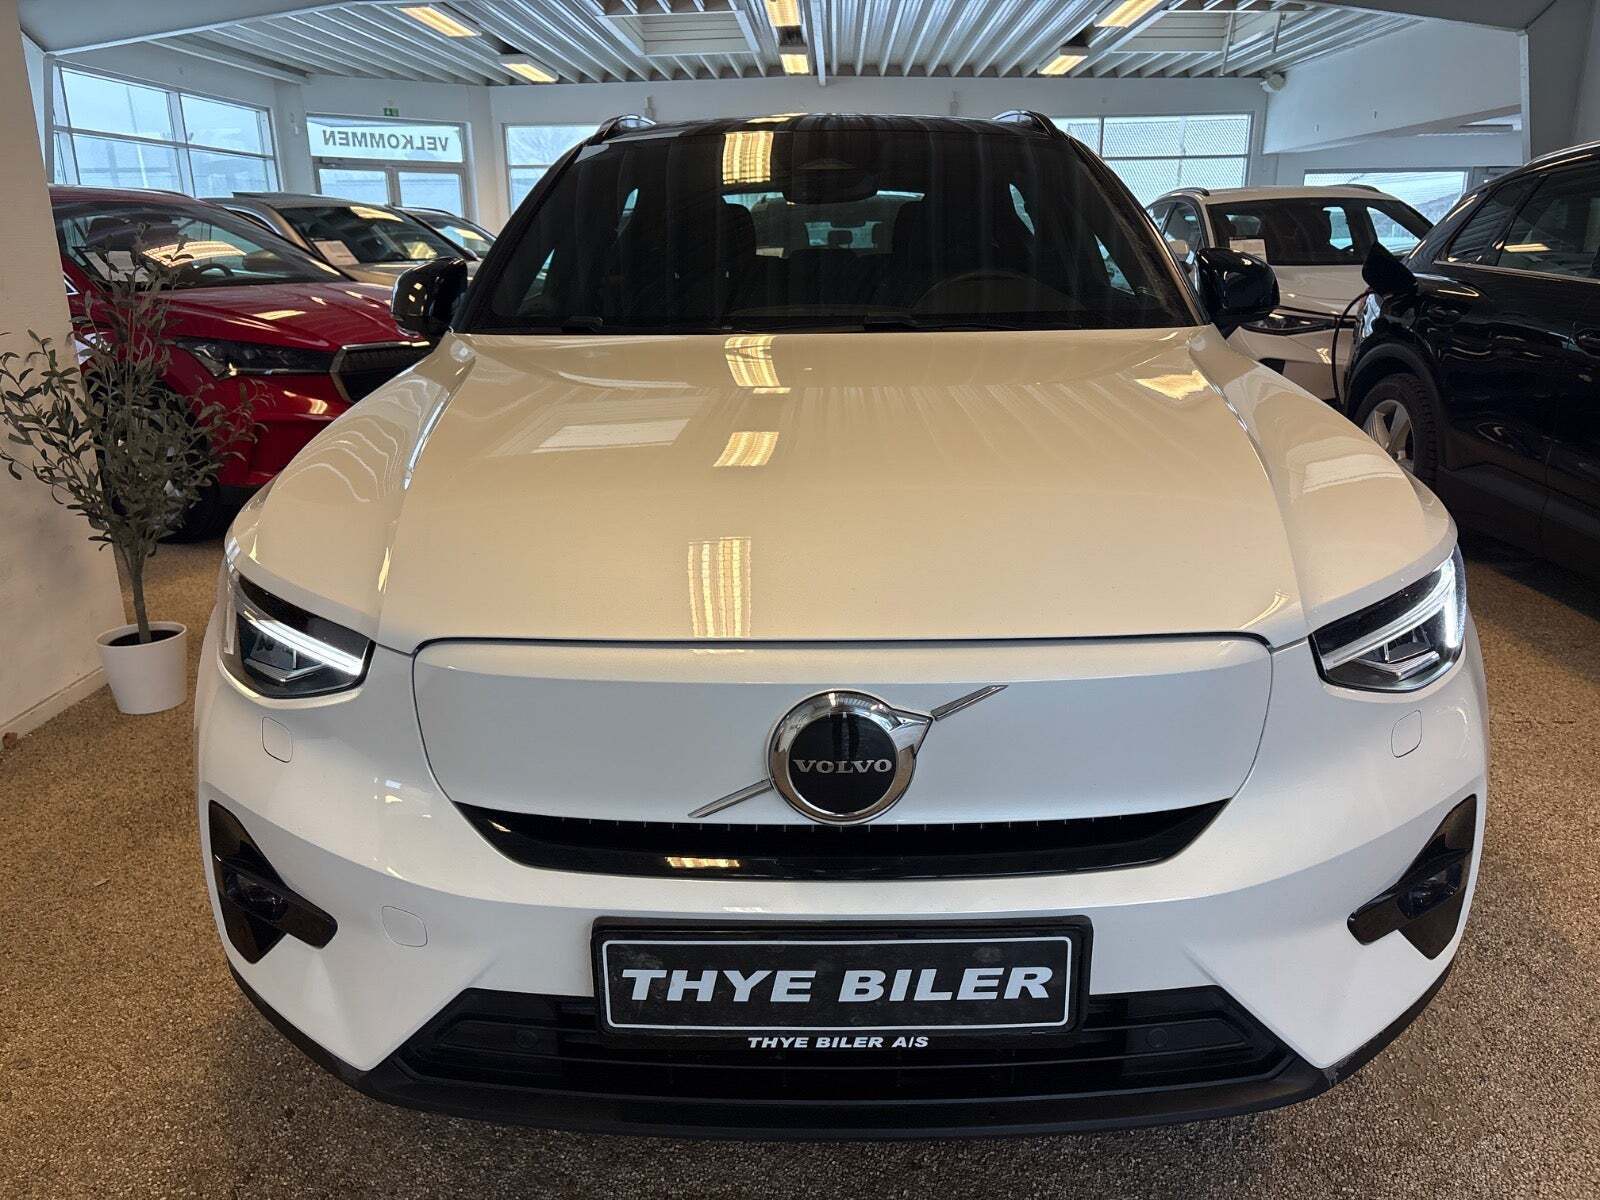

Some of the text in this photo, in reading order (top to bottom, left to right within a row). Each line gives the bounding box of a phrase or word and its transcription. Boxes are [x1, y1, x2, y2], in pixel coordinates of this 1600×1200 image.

[793, 758, 893, 774] VOLVO
[621, 966, 1054, 1003] THYE BILER
[747, 1035, 930, 1049] THYE BILER A/S
